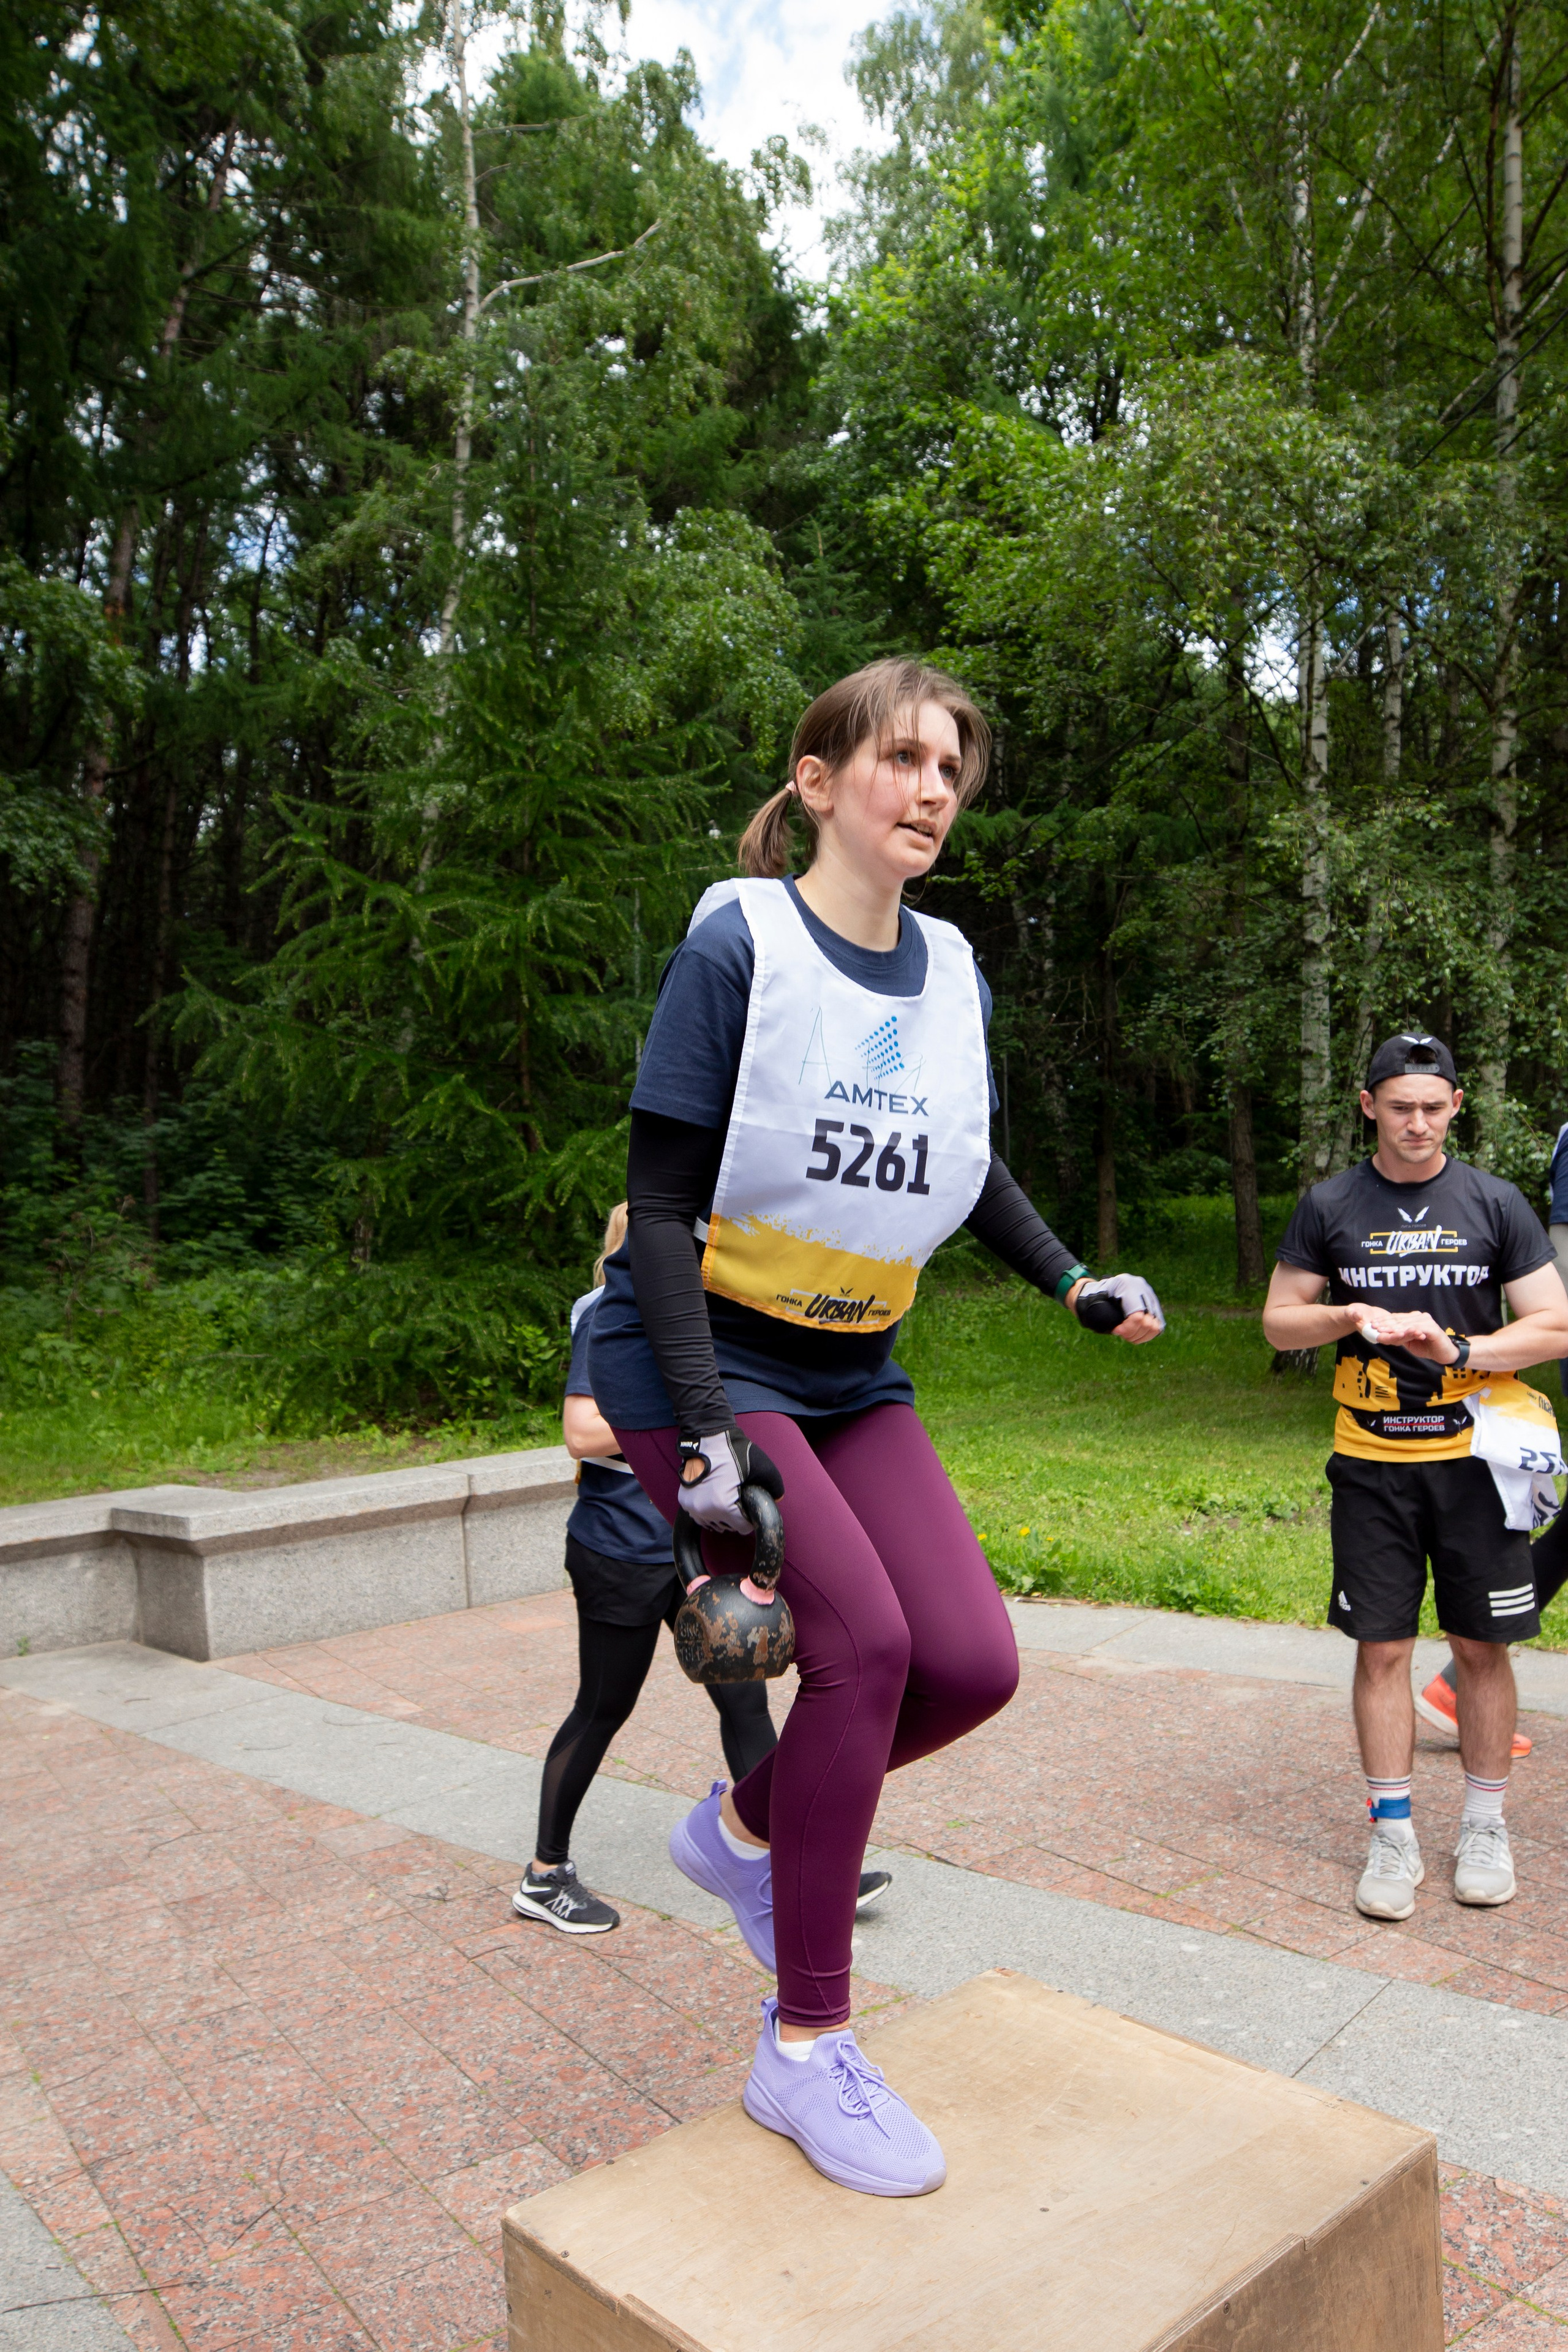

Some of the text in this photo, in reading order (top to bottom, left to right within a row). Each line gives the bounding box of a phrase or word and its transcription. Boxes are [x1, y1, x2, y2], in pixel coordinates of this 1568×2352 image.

[824, 1080, 929, 1117] AMTEX
[805, 1118, 930, 1196] 5261
[1386, 1224, 1442, 1256] URBAN
[1338, 1264, 1490, 1287] ИНСТРУКТОР
[776, 1294, 802, 1307] ГОНКА
[804, 1293, 876, 1324] URBAN
[1383, 1415, 1445, 1424] ИНСТРУКТОР
